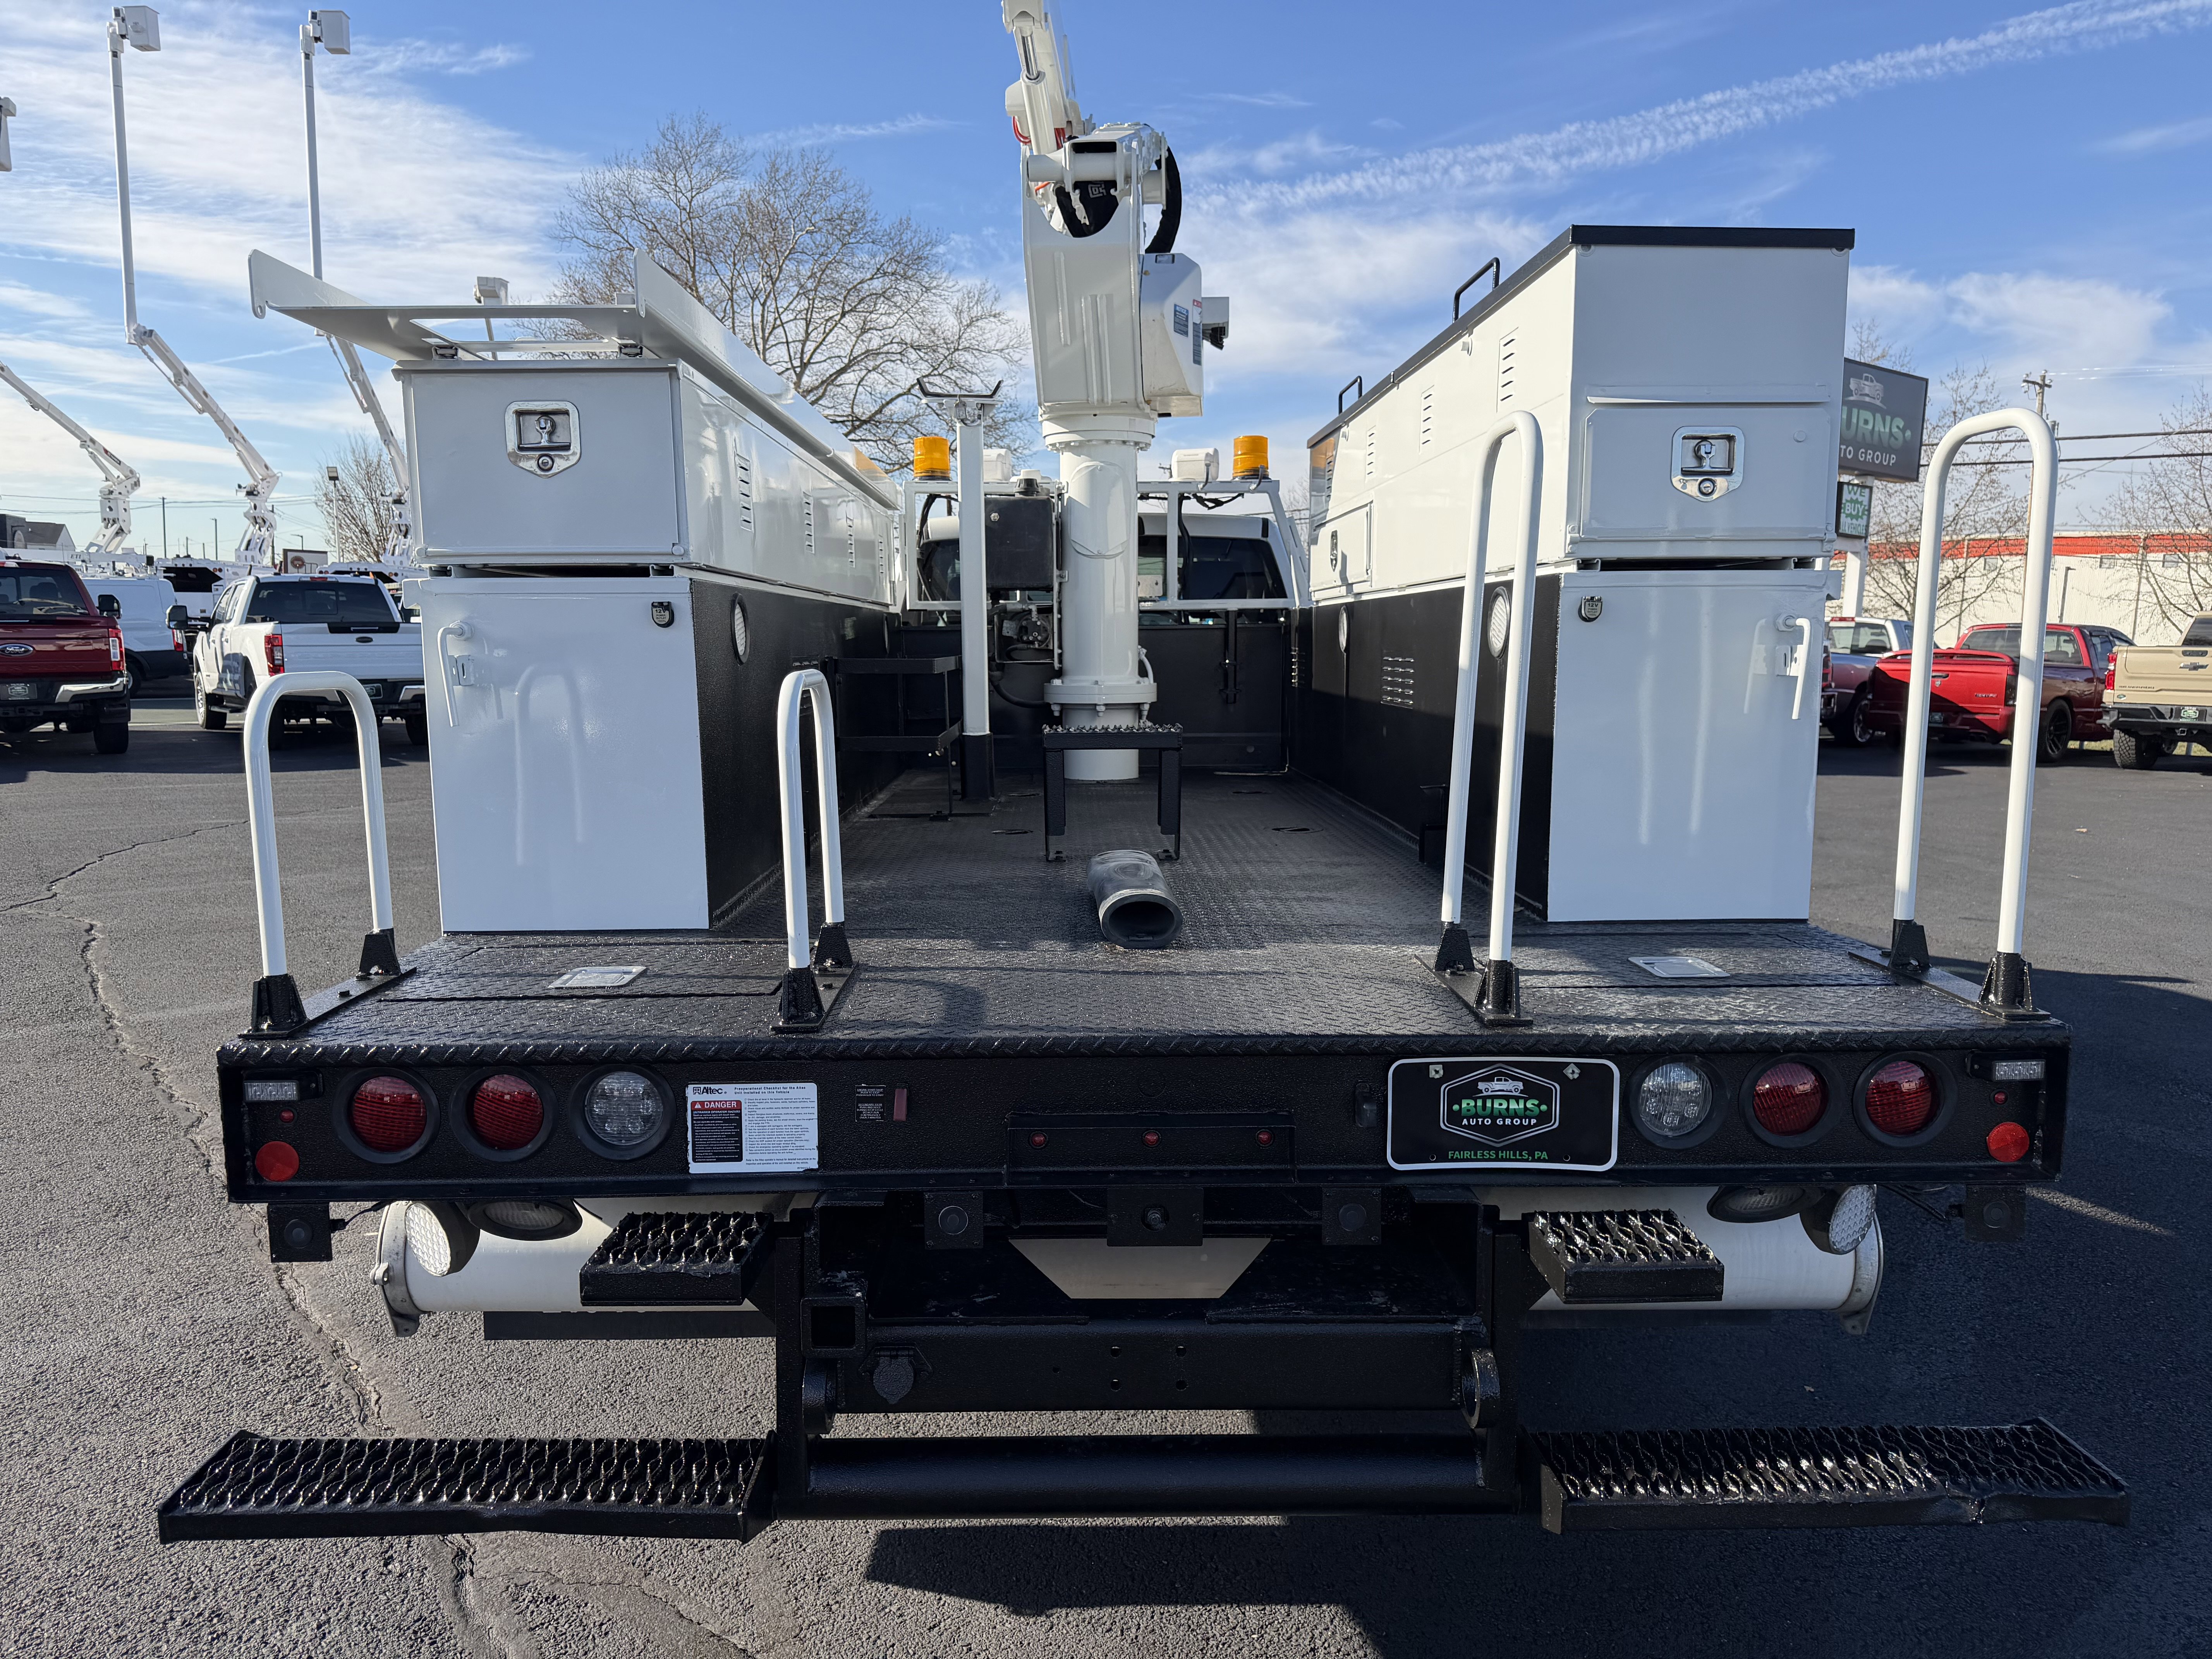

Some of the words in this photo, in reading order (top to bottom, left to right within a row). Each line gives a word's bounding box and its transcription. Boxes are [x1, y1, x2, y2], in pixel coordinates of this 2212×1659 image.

[1840, 405, 1904, 450] URNS
[1840, 445, 1853, 459] TO
[1859, 448, 1896, 466] GROUP
[1847, 485, 1866, 497] WE
[1845, 502, 1865, 516] BUY
[1462, 1099, 1540, 1117] BURNS
[1448, 1151, 1496, 1159] FAIRLESS
[1499, 1151, 1532, 1161] HILLS,
[1535, 1151, 1548, 1159] PA
